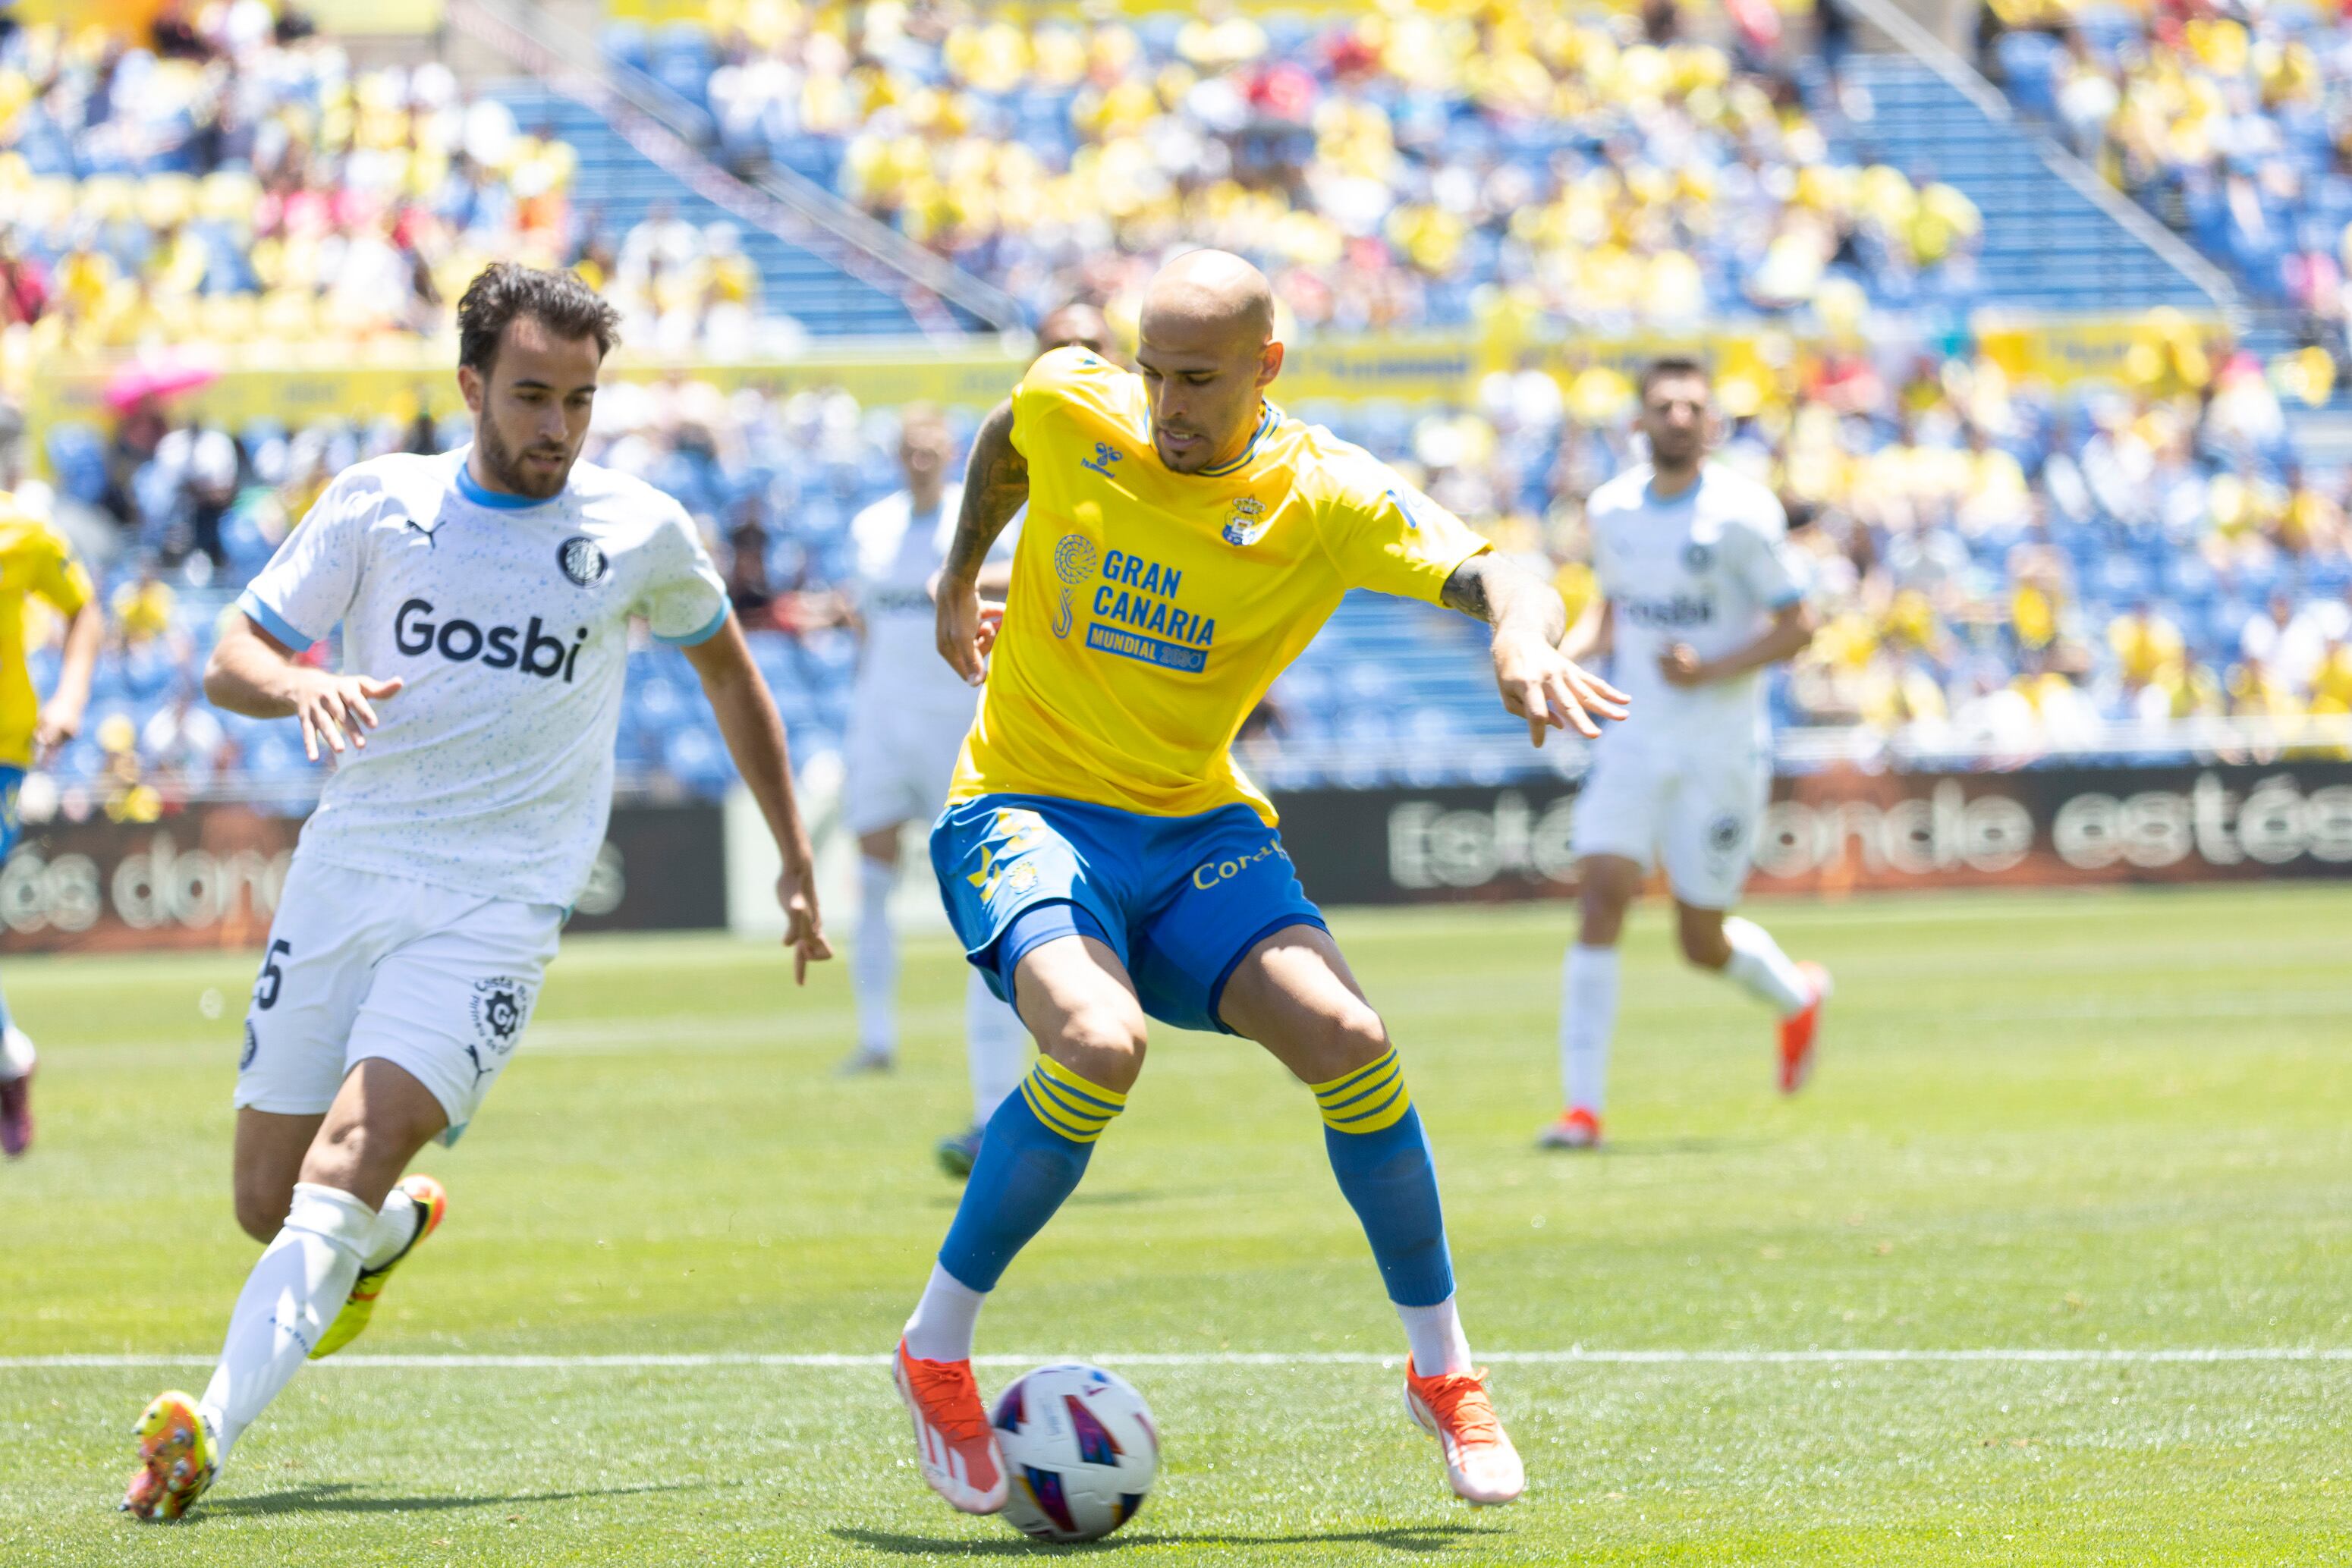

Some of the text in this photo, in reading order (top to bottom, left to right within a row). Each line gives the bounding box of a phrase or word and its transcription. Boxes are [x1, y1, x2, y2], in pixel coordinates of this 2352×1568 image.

[1102, 549, 1181, 599] GRAN
[395, 598, 588, 683] Gosbi
[1093, 585, 1215, 646] CANARIA
[1090, 627, 1156, 660] MUNDIAL
